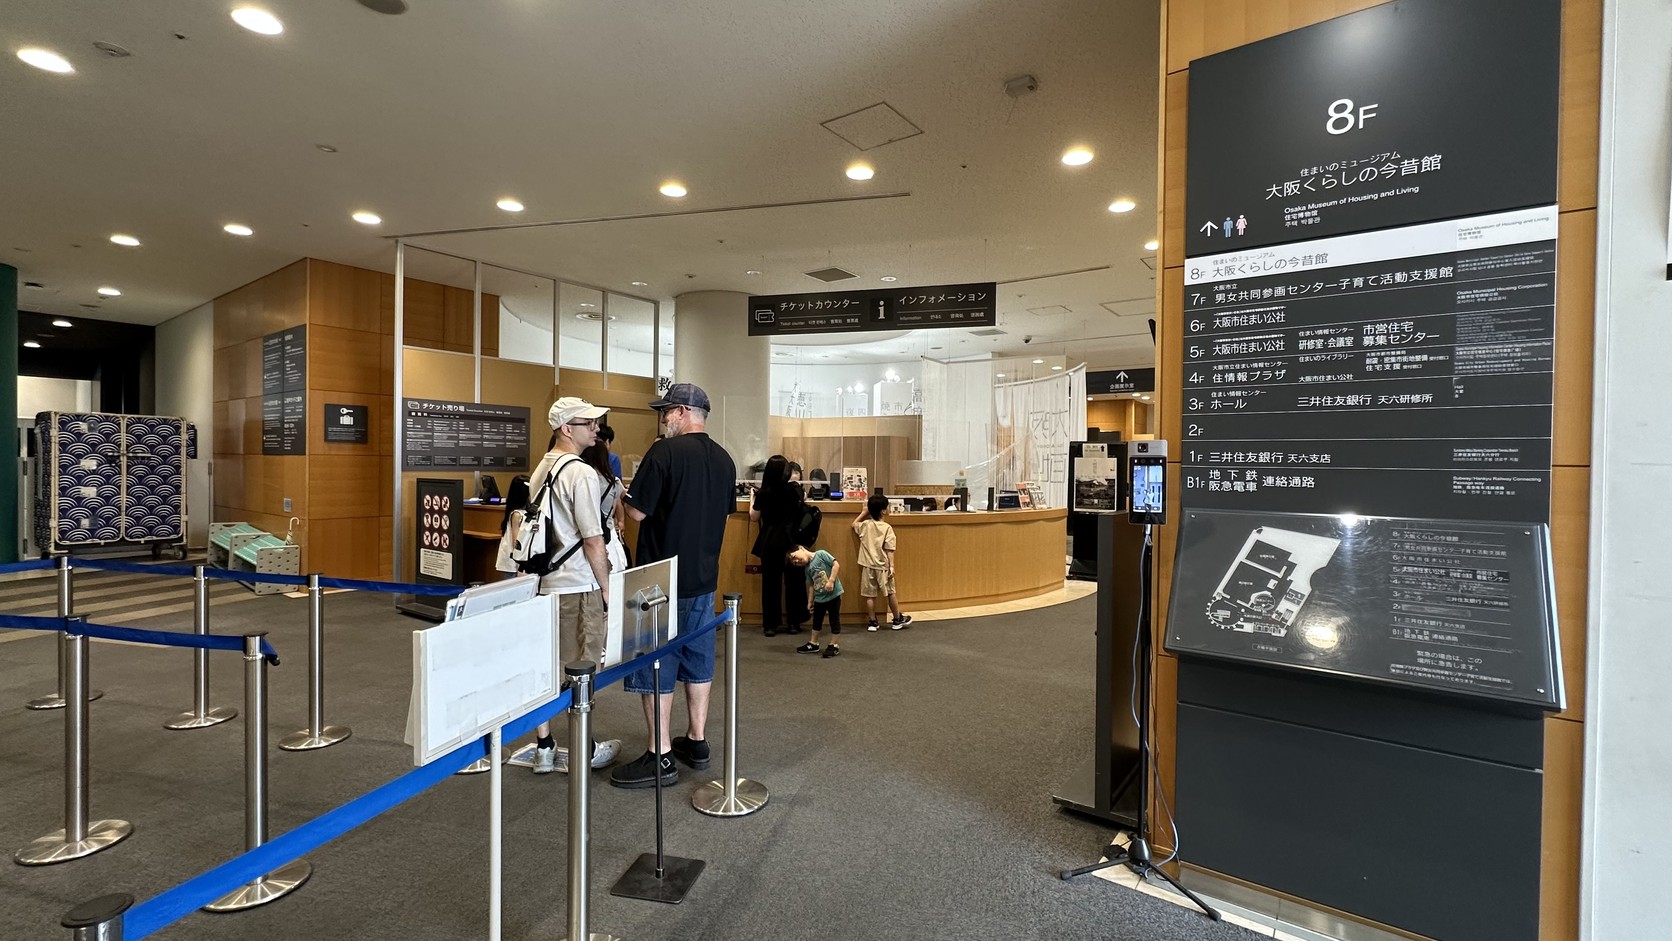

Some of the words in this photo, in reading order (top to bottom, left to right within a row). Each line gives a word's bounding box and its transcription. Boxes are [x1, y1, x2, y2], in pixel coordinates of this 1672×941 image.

[1326, 98, 1378, 135] 8F
[1300, 151, 1401, 177] 住まいのミュージアム
[1265, 154, 1442, 200] 大阪くらしの今昔館
[1284, 205, 1306, 215] Osaka
[1307, 200, 1338, 211] Museum
[1348, 193, 1378, 204] Housing
[1380, 189, 1395, 198] and
[1396, 186, 1420, 196] Living
[1212, 252, 1275, 265] 住まいのミュージアム
[1212, 253, 1329, 279] 大阪くらしの今昔館
[1190, 268, 1206, 280] 8F
[1213, 283, 1238, 292] 大阪市立
[1215, 266, 1454, 305] 男女共同参画センター子育て活動支援館
[899, 292, 987, 305] インフォメーション
[1190, 293, 1206, 306] 7F
[780, 300, 860, 312] チケットカウンター
[1190, 320, 1206, 332] 6F
[1212, 311, 1286, 329] 大阪市住まい公社
[1298, 327, 1355, 337] 住まい情報センター
[1362, 321, 1414, 336] 市営住宅
[1298, 336, 1354, 351] 研修室・会議室
[1362, 331, 1440, 347] 募集センター
[1189, 346, 1205, 358] 5F
[1212, 339, 1286, 356] 大阪市住まい公社
[1298, 353, 1355, 363] 住まいのライブラリー
[1212, 361, 1289, 371] 大阪市立住まい情報センター
[1188, 372, 1205, 384] 4F
[1212, 369, 1287, 384] 住情報プラザ
[1298, 373, 1354, 383] 大阪市住まい公社
[1211, 390, 1267, 398] 住まい情報センター
[1297, 394, 1373, 407] 三井住友銀行
[1377, 393, 1434, 405] 天六研修所
[422, 403, 465, 412] チケット売り場
[1188, 398, 1204, 411] 3F
[1210, 398, 1248, 410] ホール
[1188, 424, 1204, 437] 2F
[1189, 450, 1203, 463] 1F
[1208, 452, 1284, 464] 三井住友銀行
[1287, 453, 1331, 464] 天六支店
[1208, 469, 1258, 481] 地下鉄
[1187, 476, 1205, 489] B1F
[1208, 480, 1258, 493] 阪急電車
[1262, 475, 1316, 489] 連絡通路
